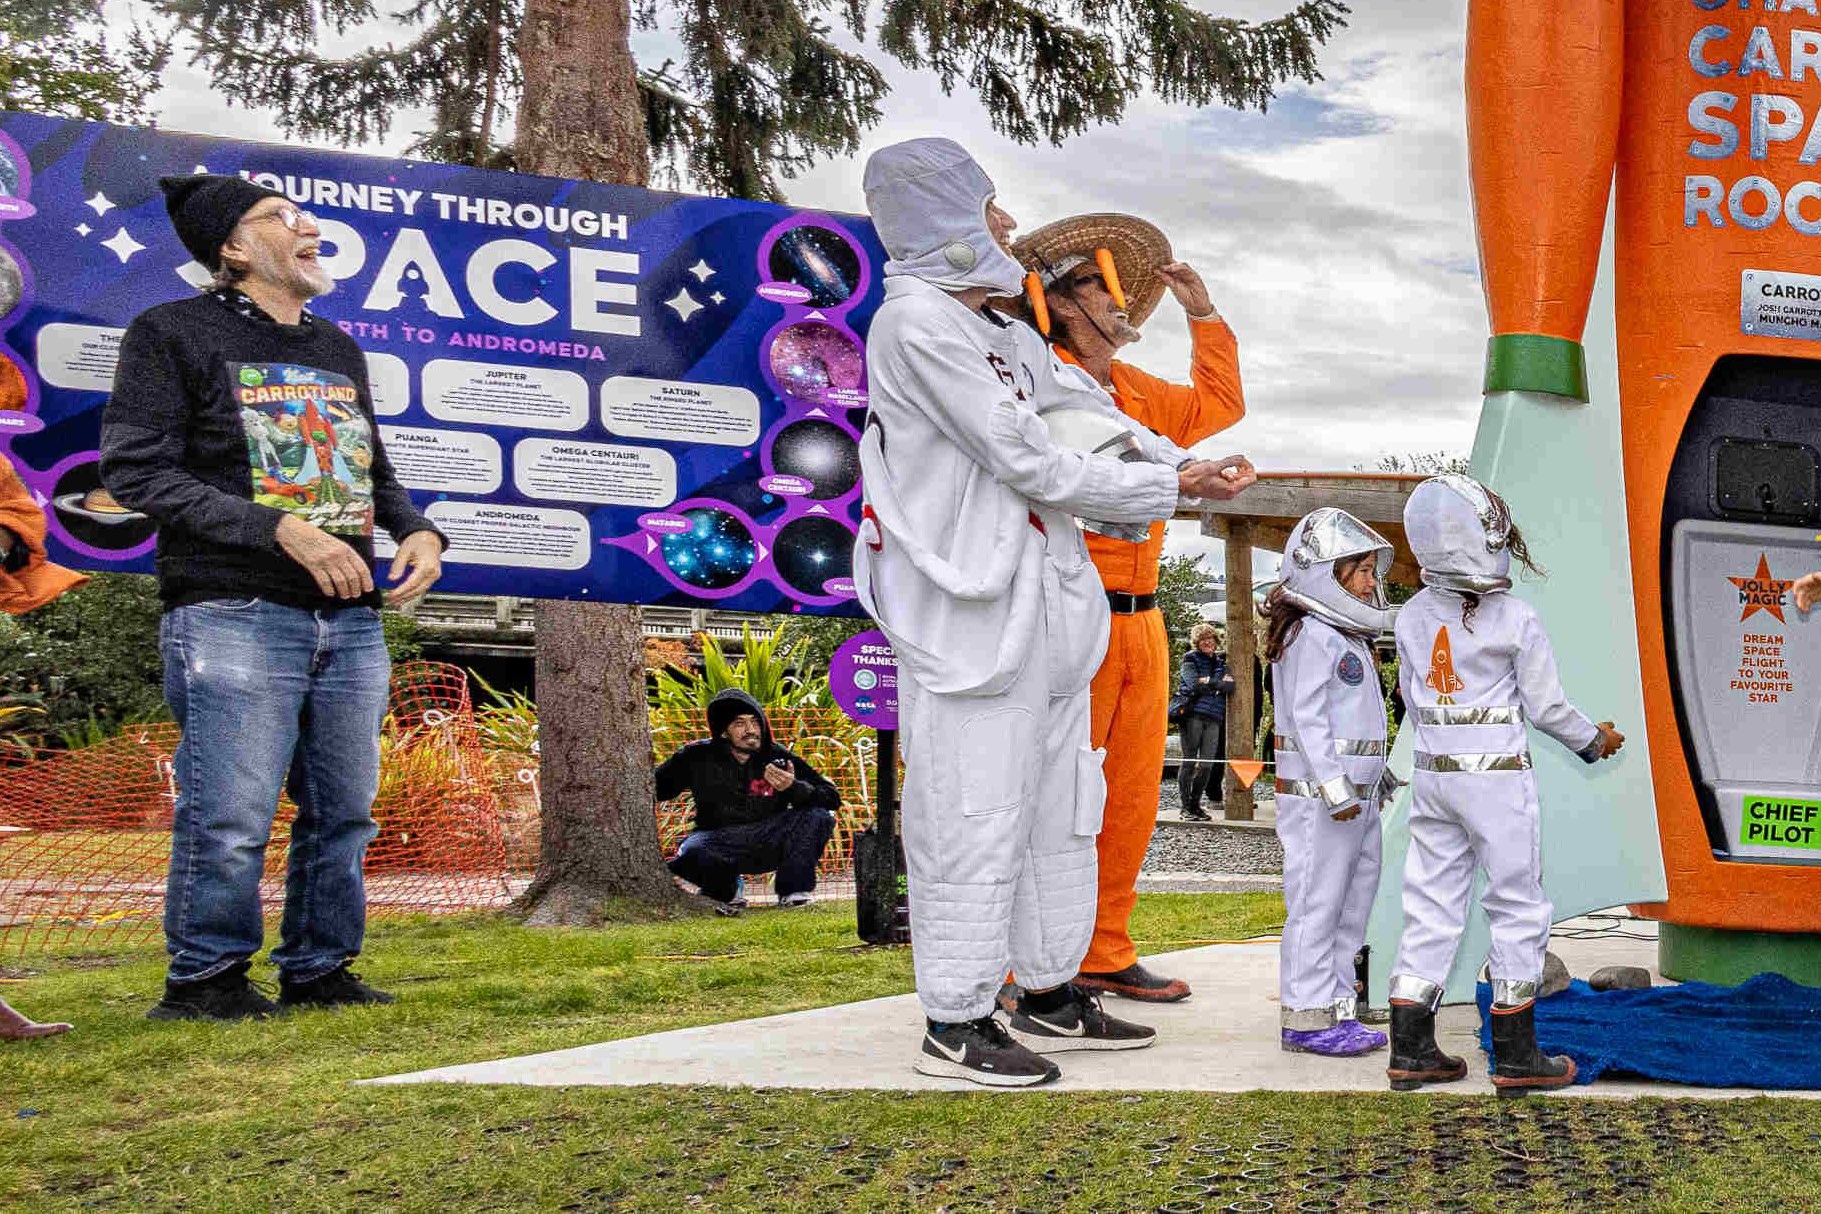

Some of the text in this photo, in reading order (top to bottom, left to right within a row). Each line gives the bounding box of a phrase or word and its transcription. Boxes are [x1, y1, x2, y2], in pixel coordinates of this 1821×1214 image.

[431, 192, 628, 240] THROUGH
[176, 218, 642, 337] PACE
[338, 320, 607, 362] RTH TO ANDROMEDA
[485, 370, 528, 381] JUPITER
[241, 385, 355, 403] CARROTLAND
[661, 386, 701, 397] SATURN
[395, 433, 439, 443] PUANGA
[551, 446, 639, 461] OMEGA CENTAURI
[474, 510, 540, 522] ANDROMEDA
[1739, 579, 1786, 594] JOLLY
[1738, 593, 1787, 606] MAGIC
[1743, 633, 1784, 645] DREAM
[1743, 645, 1781, 656] SPACE
[852, 654, 898, 666] THANKS
[1742, 657, 1785, 668] FLIGHT
[1738, 669, 1789, 680] TO YOUR
[1730, 680, 1793, 692] FAVOURITE
[1748, 693, 1778, 703] STAR
[1750, 801, 1819, 823] CHIEF
[1748, 822, 1815, 844] PILOT
